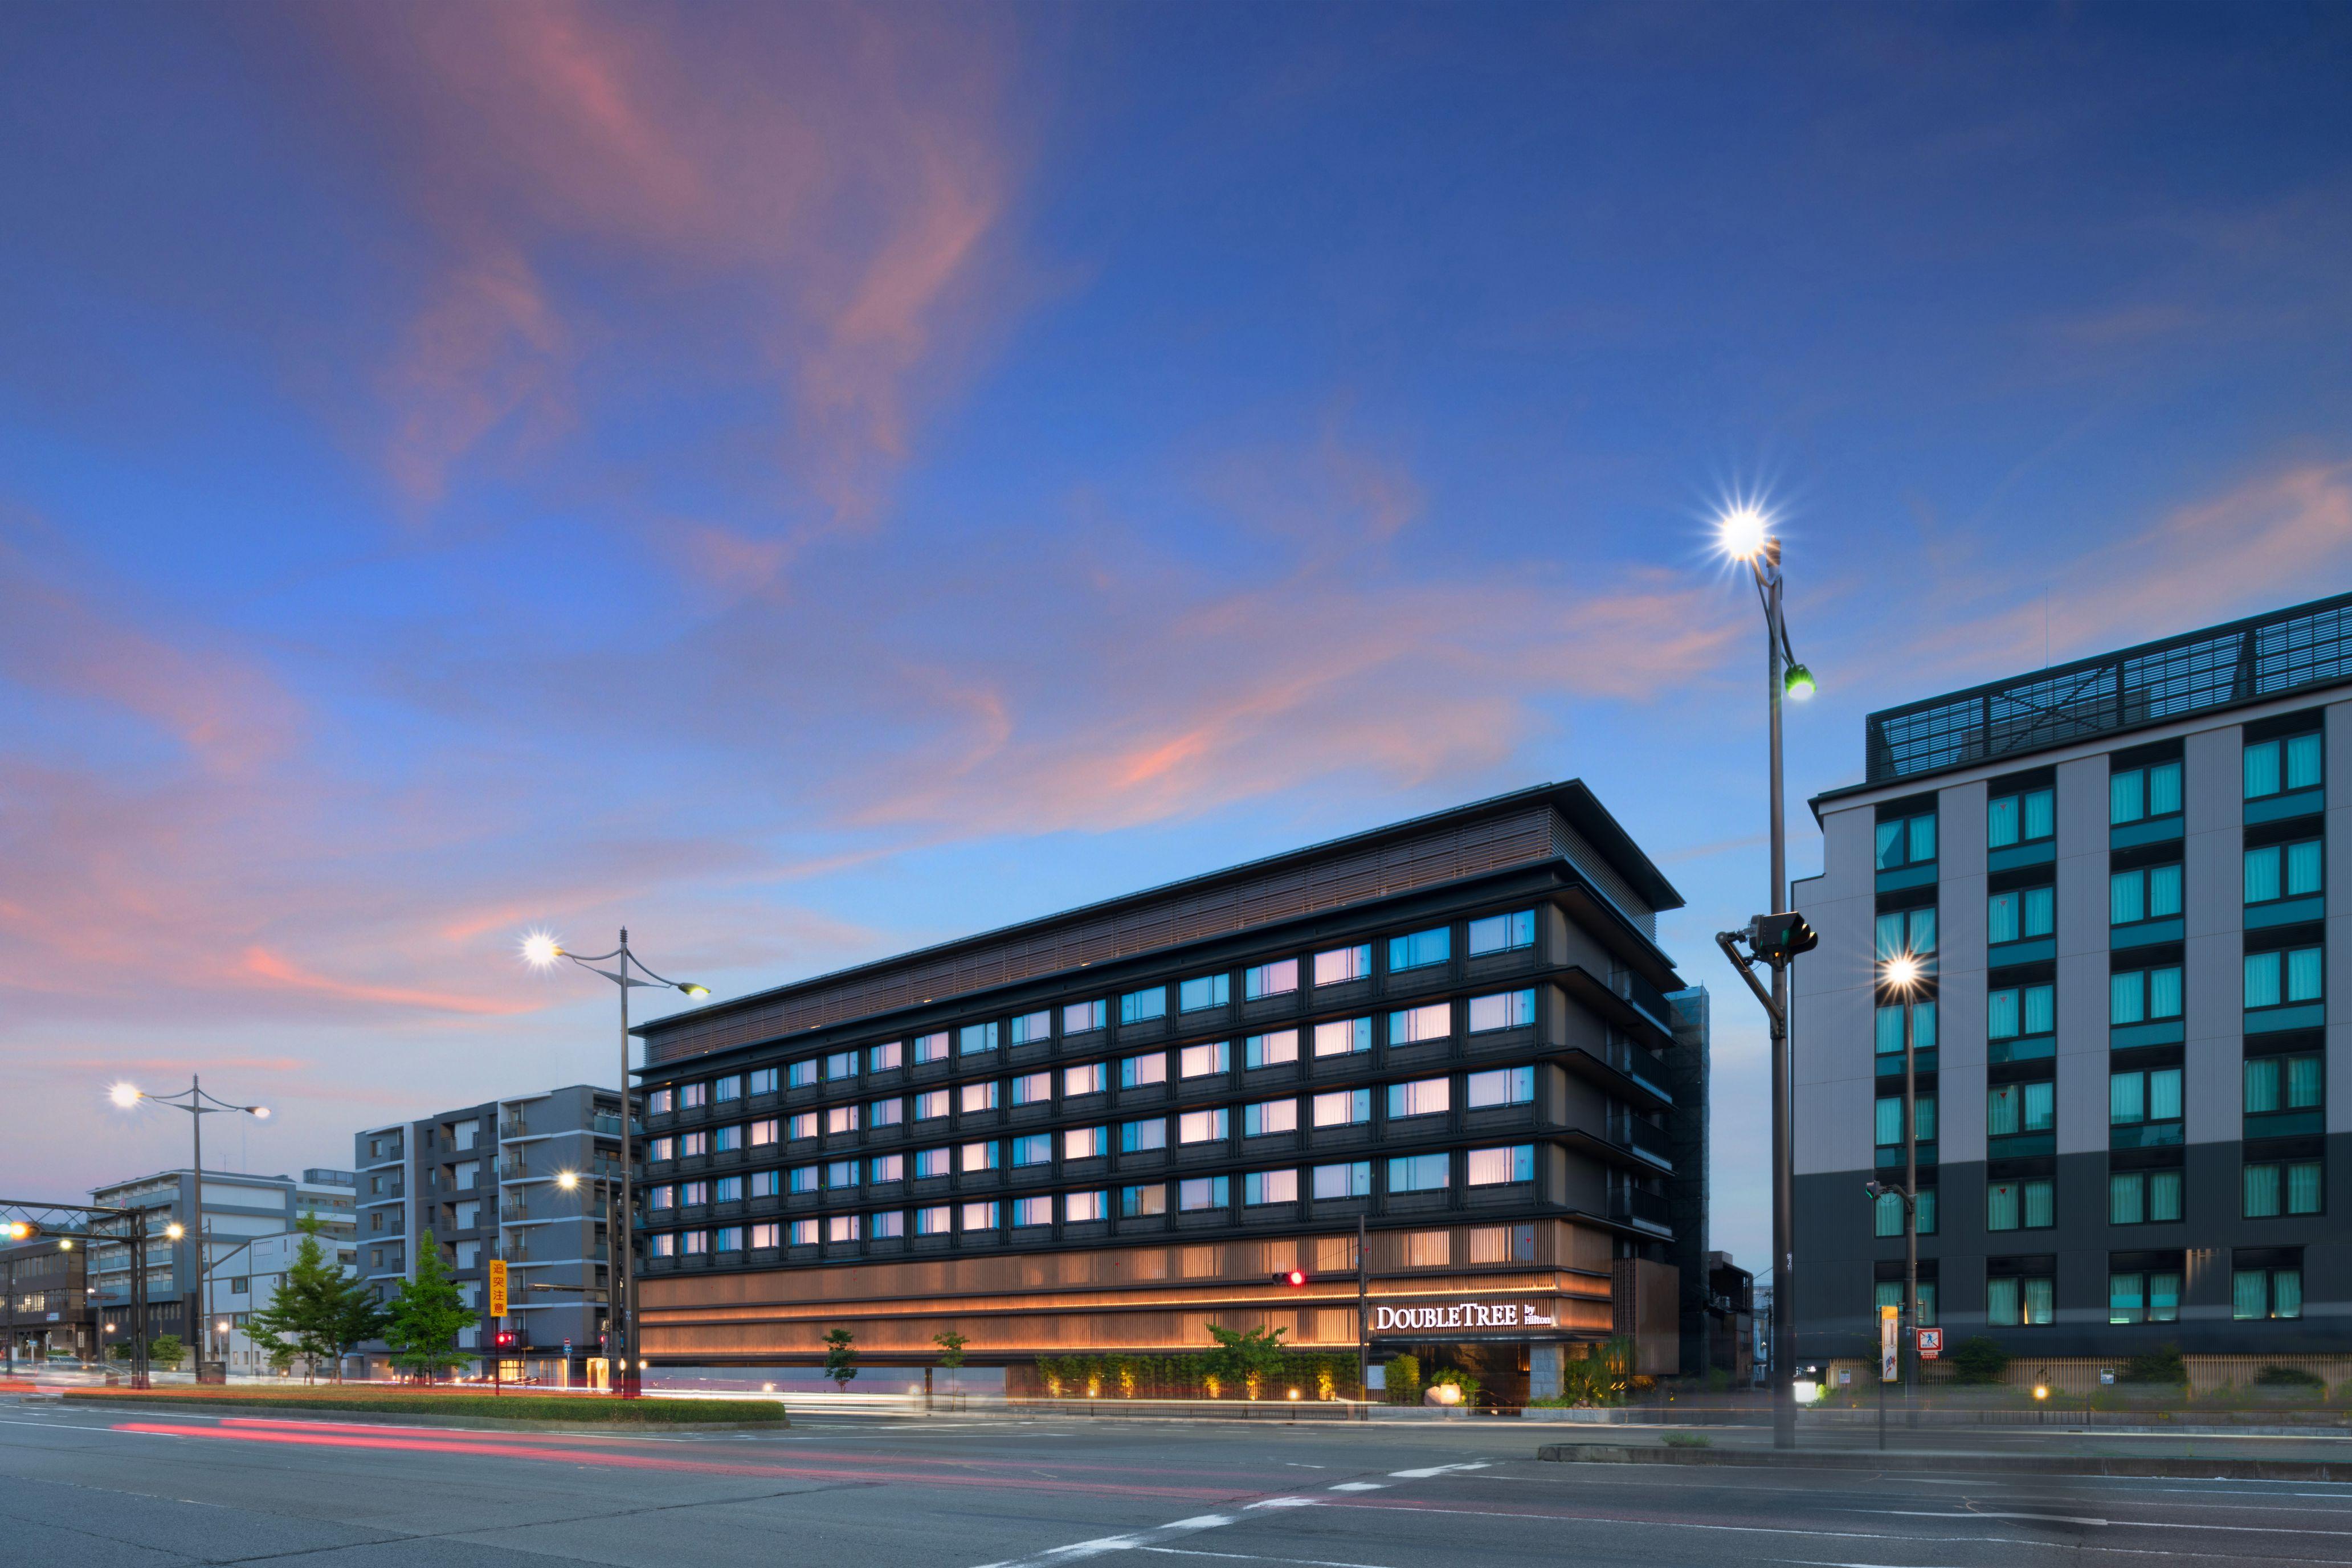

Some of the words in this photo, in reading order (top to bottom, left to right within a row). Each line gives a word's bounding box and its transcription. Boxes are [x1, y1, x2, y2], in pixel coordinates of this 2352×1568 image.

[493, 1263, 504, 1313] 追突注意
[1377, 1303, 1518, 1329] DOUBLETREE
[1524, 1304, 1536, 1316] by
[1524, 1315, 1551, 1325] Hilton
